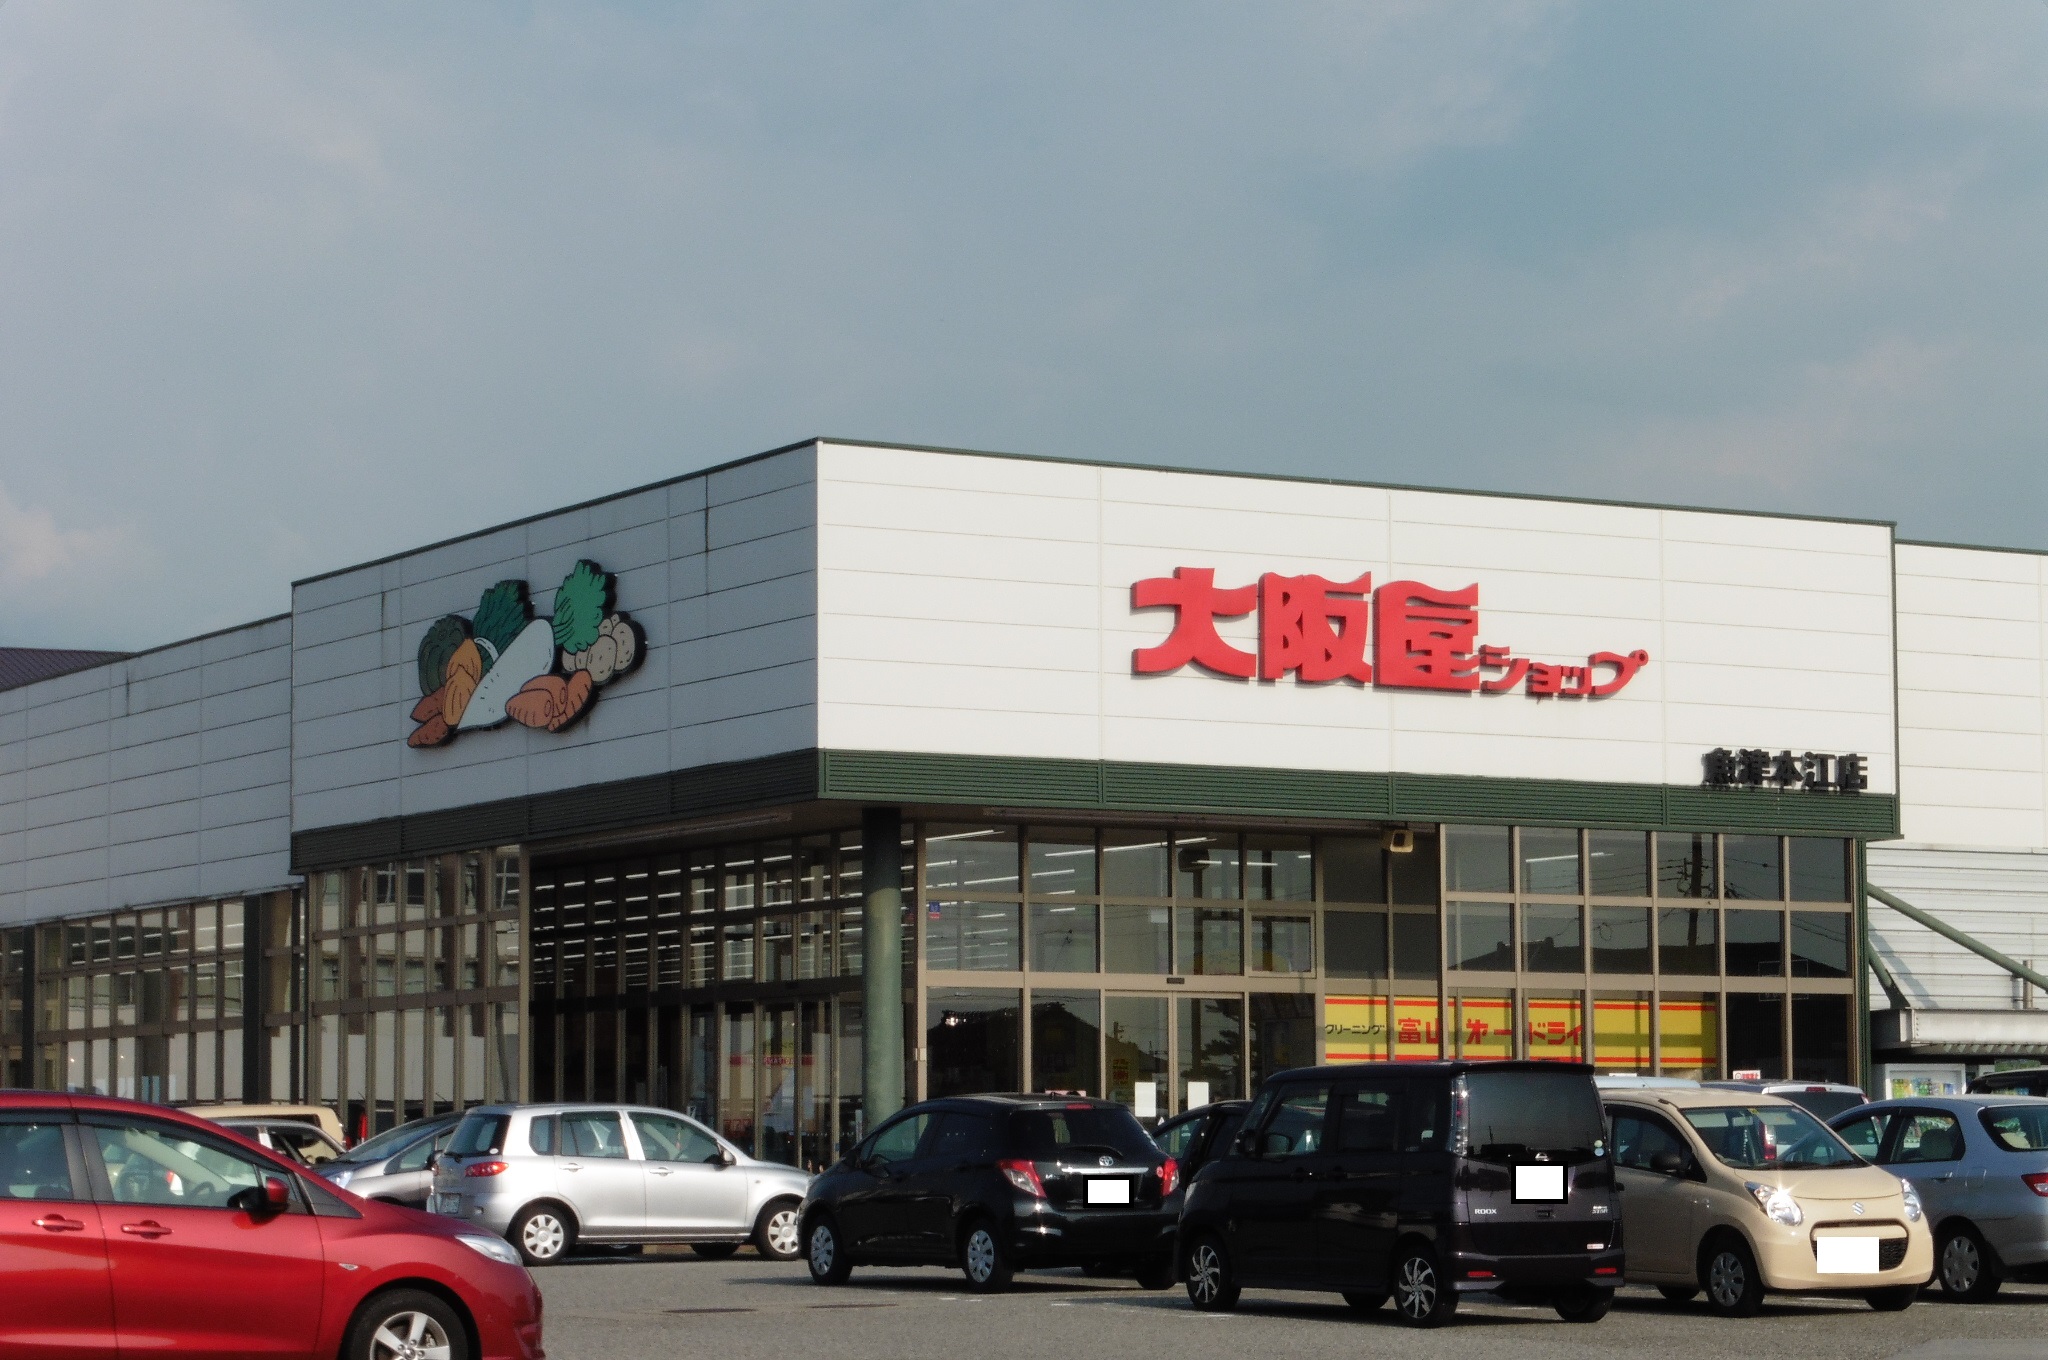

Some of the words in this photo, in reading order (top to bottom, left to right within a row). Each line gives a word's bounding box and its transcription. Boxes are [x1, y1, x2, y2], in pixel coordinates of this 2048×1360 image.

[1130, 566, 1649, 698] 大阪屋ショップ
[1325, 1024, 1385, 1035] クリーニング
